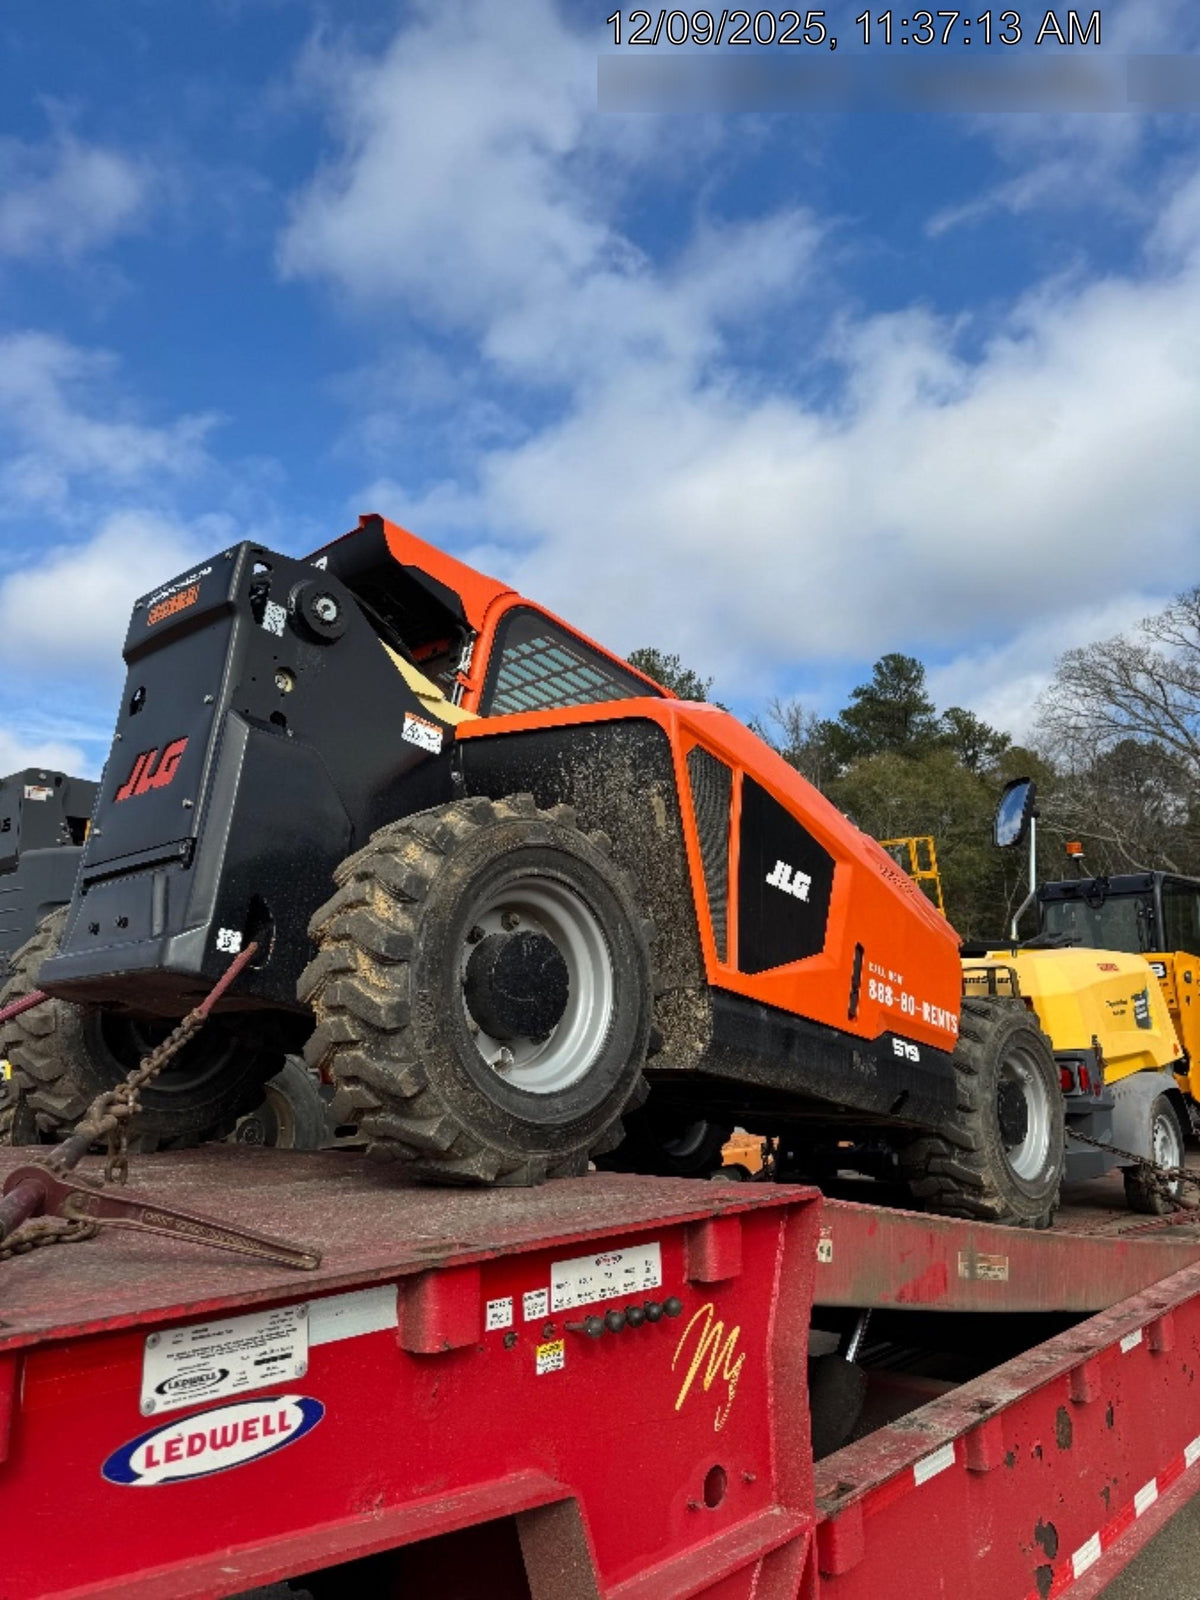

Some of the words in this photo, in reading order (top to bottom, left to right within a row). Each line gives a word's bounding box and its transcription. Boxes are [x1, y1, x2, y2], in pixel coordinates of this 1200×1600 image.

[114, 736, 189, 803] JLG
[765, 859, 812, 903] JLG
[868, 978, 959, 1034] 888-80-RENTS
[144, 1410, 292, 1469] LEDWELL
